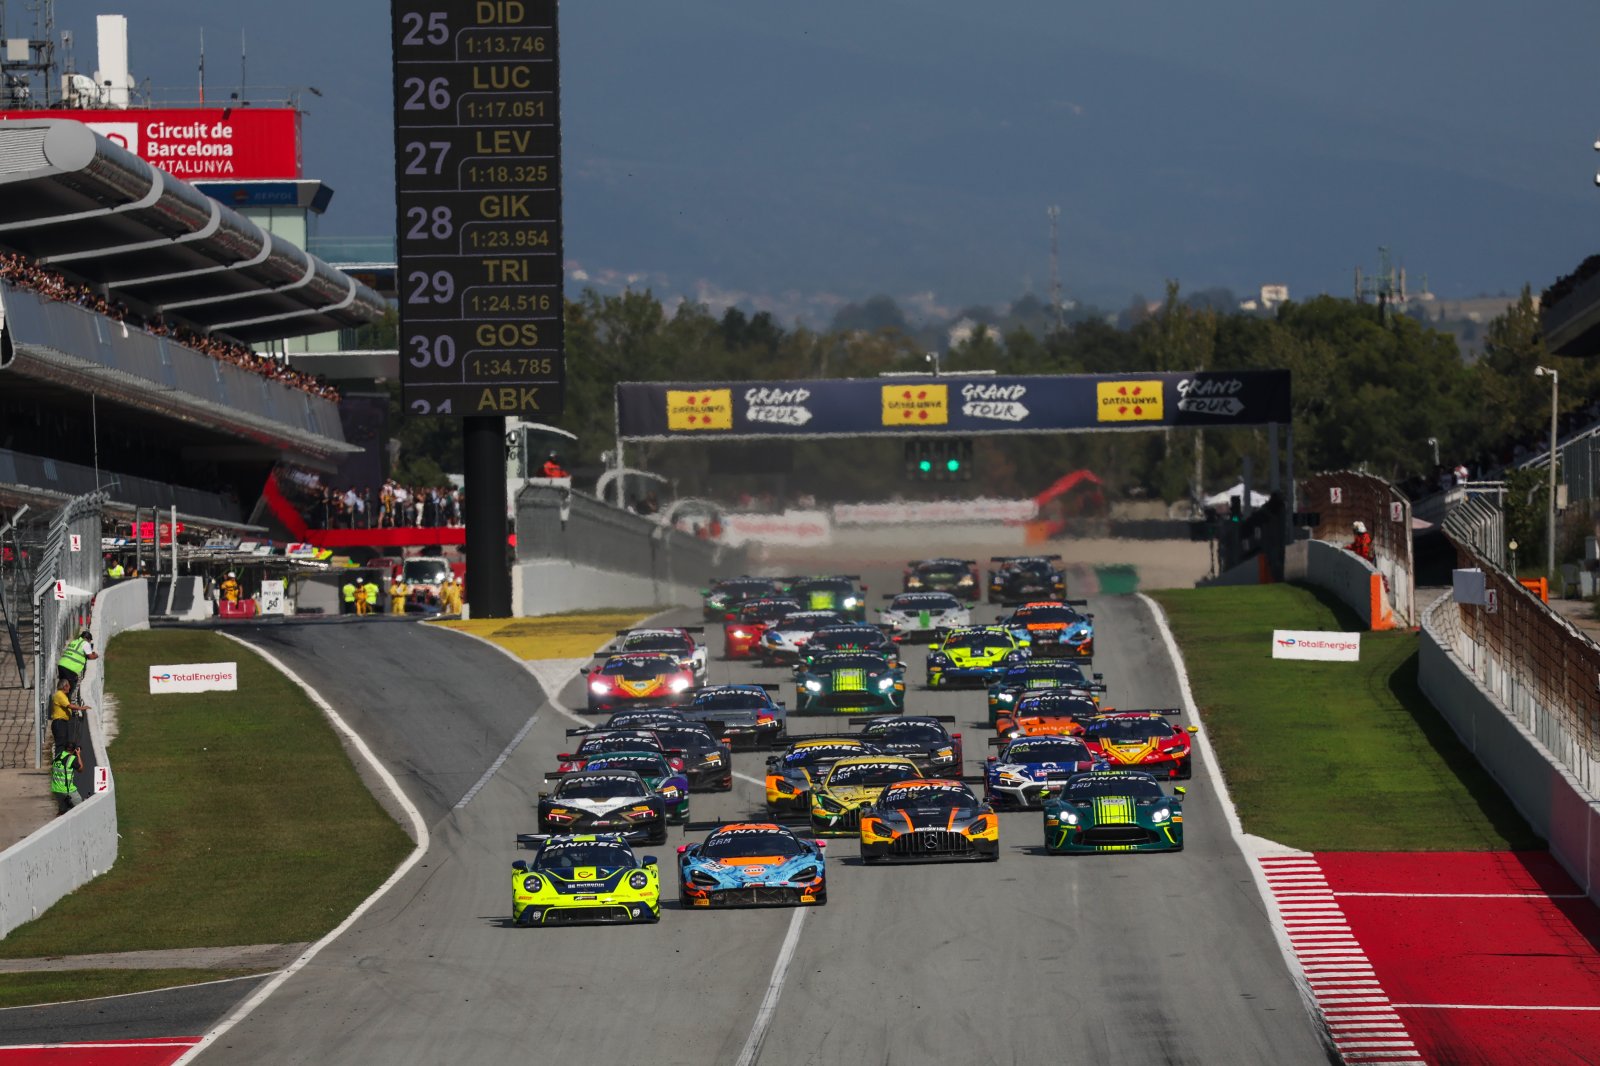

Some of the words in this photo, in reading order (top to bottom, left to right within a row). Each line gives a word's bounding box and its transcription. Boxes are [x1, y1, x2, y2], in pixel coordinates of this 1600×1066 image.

[476, 1, 525, 24] DID
[402, 12, 449, 46] 25
[465, 36, 545, 54] 1:13.746
[473, 65, 531, 90] LUC
[403, 77, 450, 110] 26
[467, 101, 545, 118] 1:17.051
[146, 122, 208, 139] Circuit
[211, 122, 233, 138] de
[147, 141, 234, 157] Barcelona
[476, 130, 532, 154] LEV
[404, 141, 451, 175] 27
[469, 166, 548, 183] 1:18.325
[479, 195, 531, 218] GIK
[406, 206, 453, 240] 28
[470, 230, 549, 247] 1:23.954
[482, 259, 528, 283] TRI
[408, 270, 455, 304] 29
[471, 295, 550, 312] 1:24.516
[476, 324, 539, 347] GOS
[409, 334, 456, 368] 30
[473, 358, 551, 376] 1:34.785
[744, 387, 811, 405] GRAND
[961, 384, 1027, 401] GRAND
[1176, 379, 1242, 398] GRAND
[477, 387, 540, 411] ABK
[1102, 396, 1158, 406] CATALUNYA
[753, 407, 799, 421] TOUR
[969, 403, 1017, 419] TOUR
[1297, 640, 1357, 650] TotalEnergies
[172, 672, 233, 682] TotalEnergies
[868, 721, 937, 731] FANATEC
[585, 737, 653, 746] FANATEC
[793, 744, 862, 755] FANATEC
[1012, 740, 1081, 749] FANATEC
[588, 756, 658, 766] FANATEC
[838, 764, 909, 774] FANATEC
[566, 776, 636, 785] FANATEC
[888, 786, 962, 796] FANATEC
[711, 829, 790, 839] FANATEC
[544, 841, 622, 852] FANATEC
